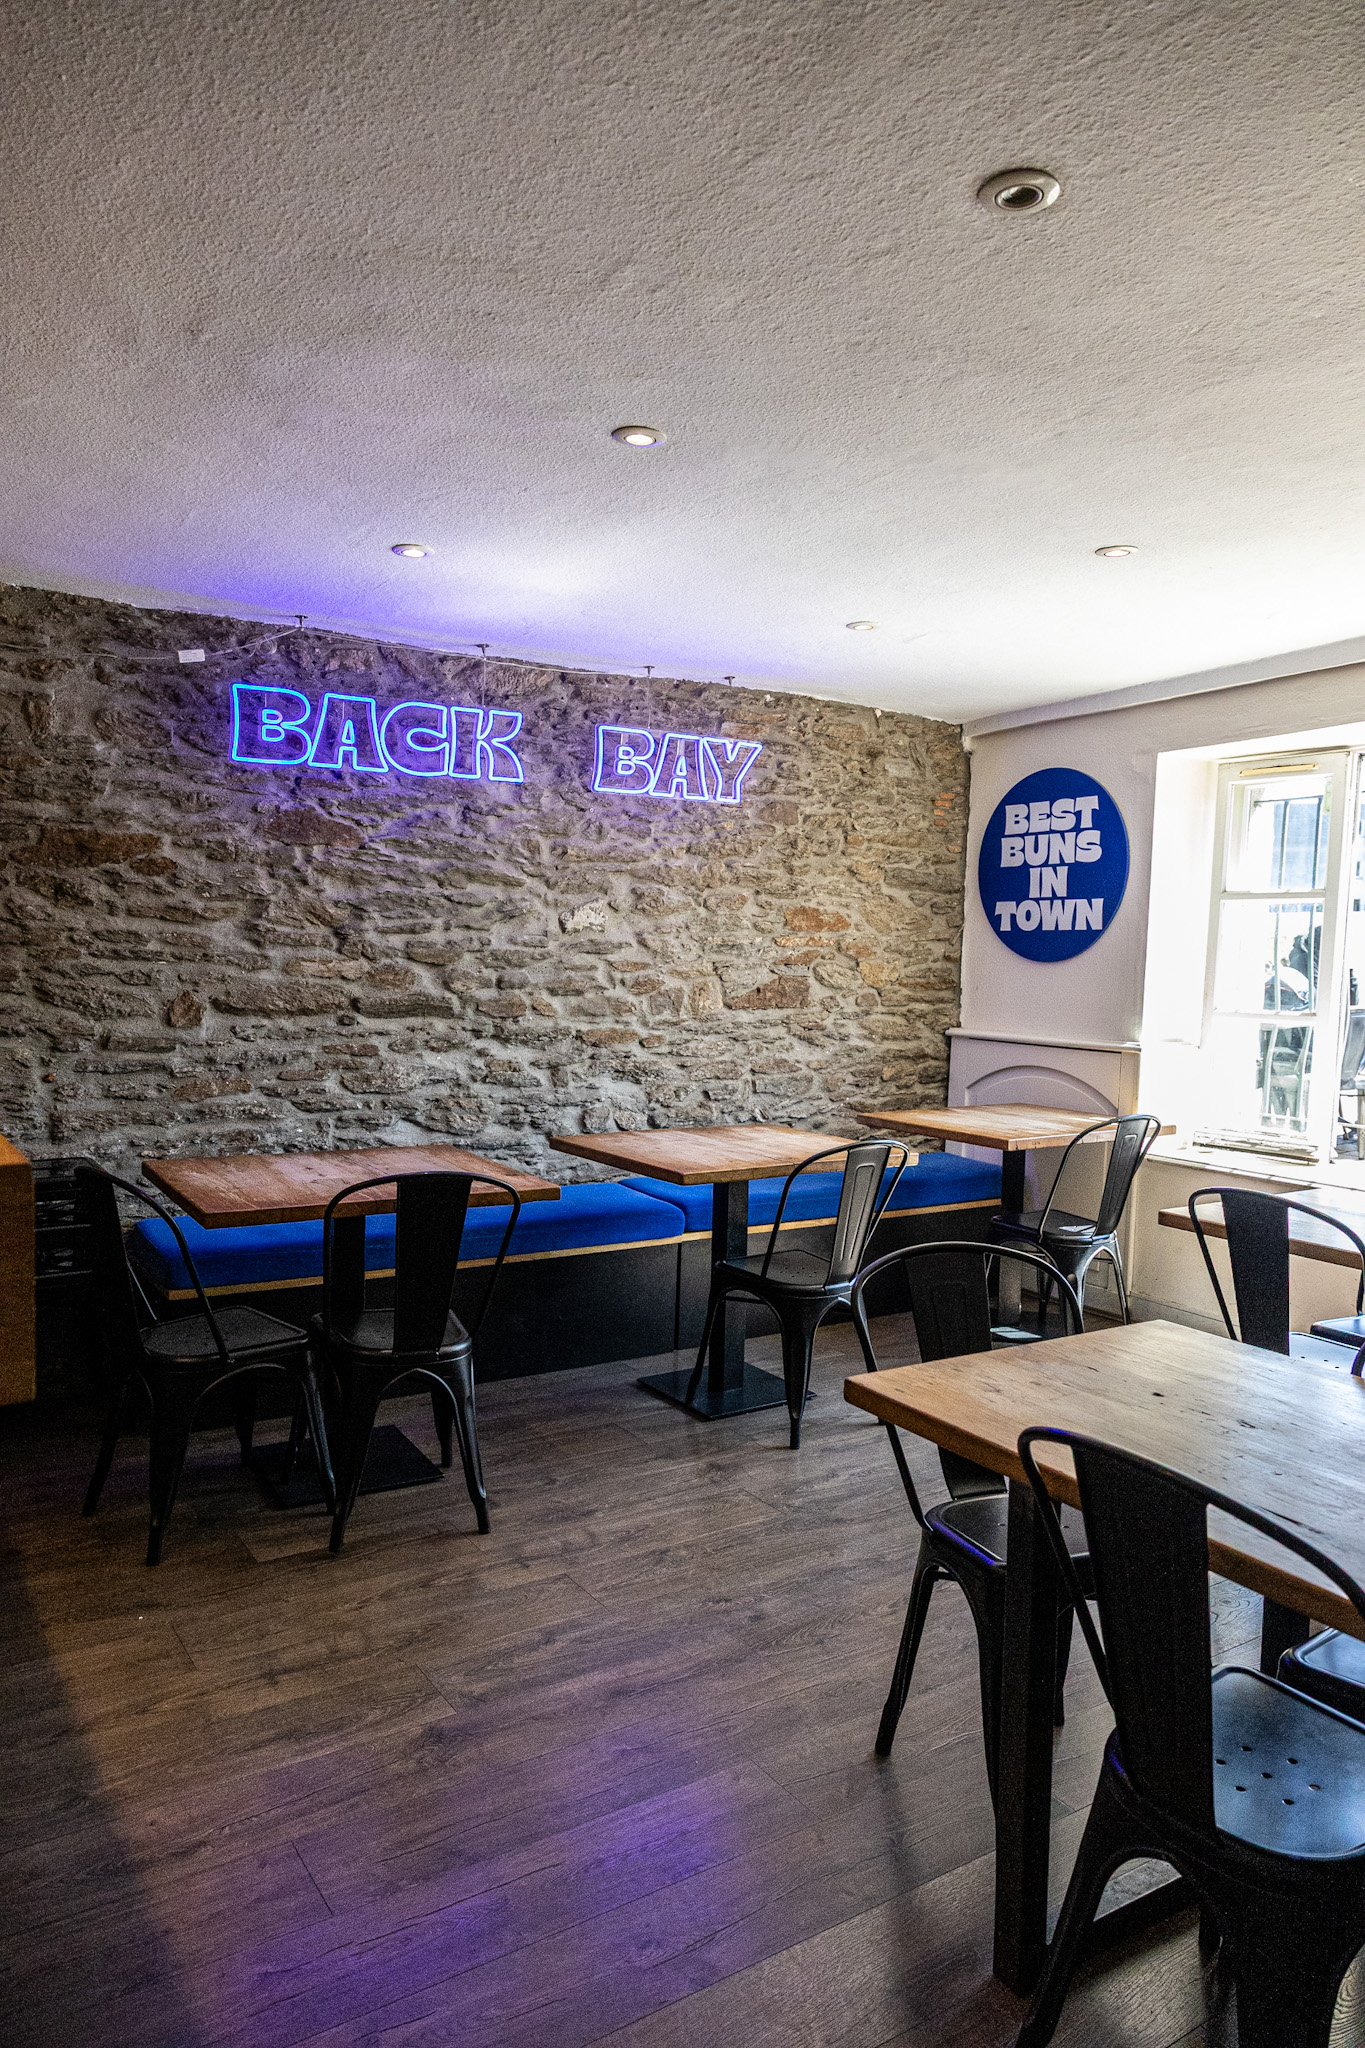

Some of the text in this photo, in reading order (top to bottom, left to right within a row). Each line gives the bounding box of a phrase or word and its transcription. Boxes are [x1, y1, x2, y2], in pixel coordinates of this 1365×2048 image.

[230, 683, 763, 803] BACK BAY
[1004, 795, 1099, 835] BEST
[1000, 830, 1102, 867] BUNS
[1028, 866, 1069, 898] IN
[994, 898, 1104, 931] TOWN
